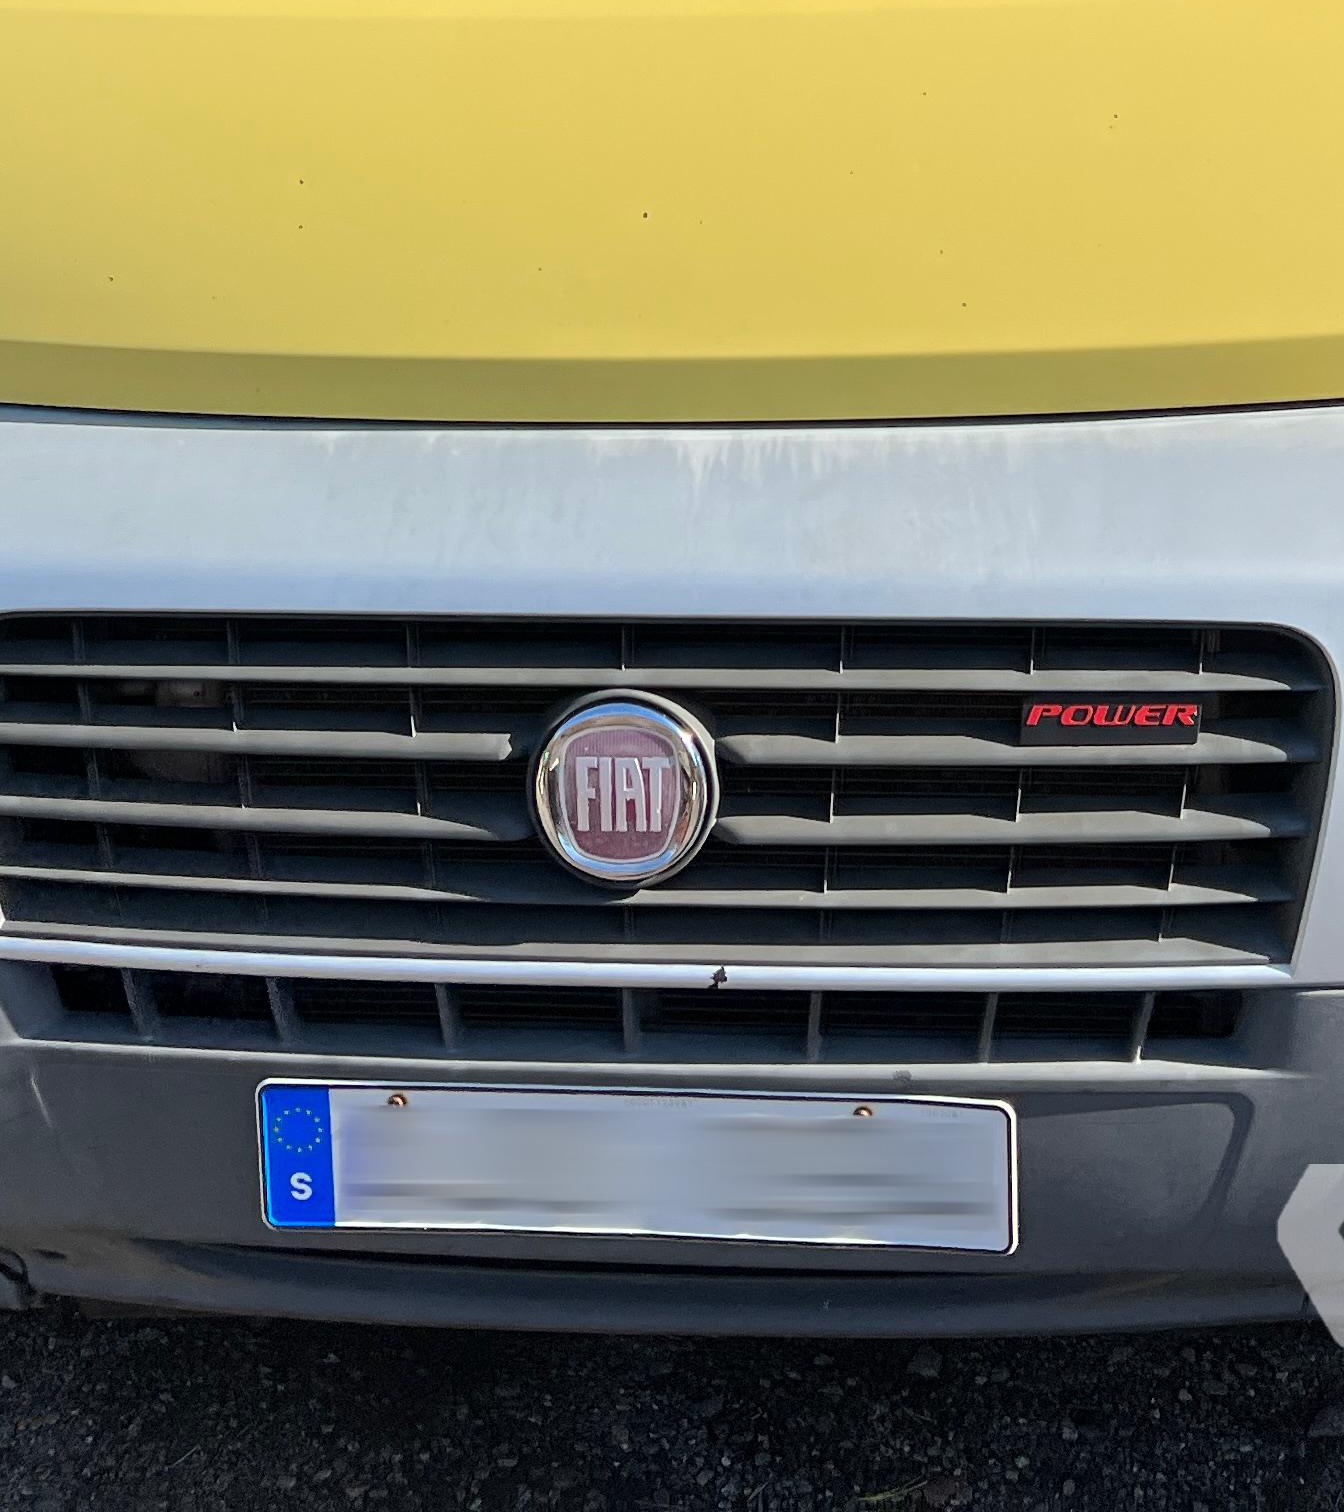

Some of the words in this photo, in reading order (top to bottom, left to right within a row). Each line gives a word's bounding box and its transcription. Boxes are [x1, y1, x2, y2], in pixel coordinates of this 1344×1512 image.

[1026, 703, 1198, 726] POWER
[575, 756, 671, 833] FIAT
[290, 1172, 313, 1201] S
